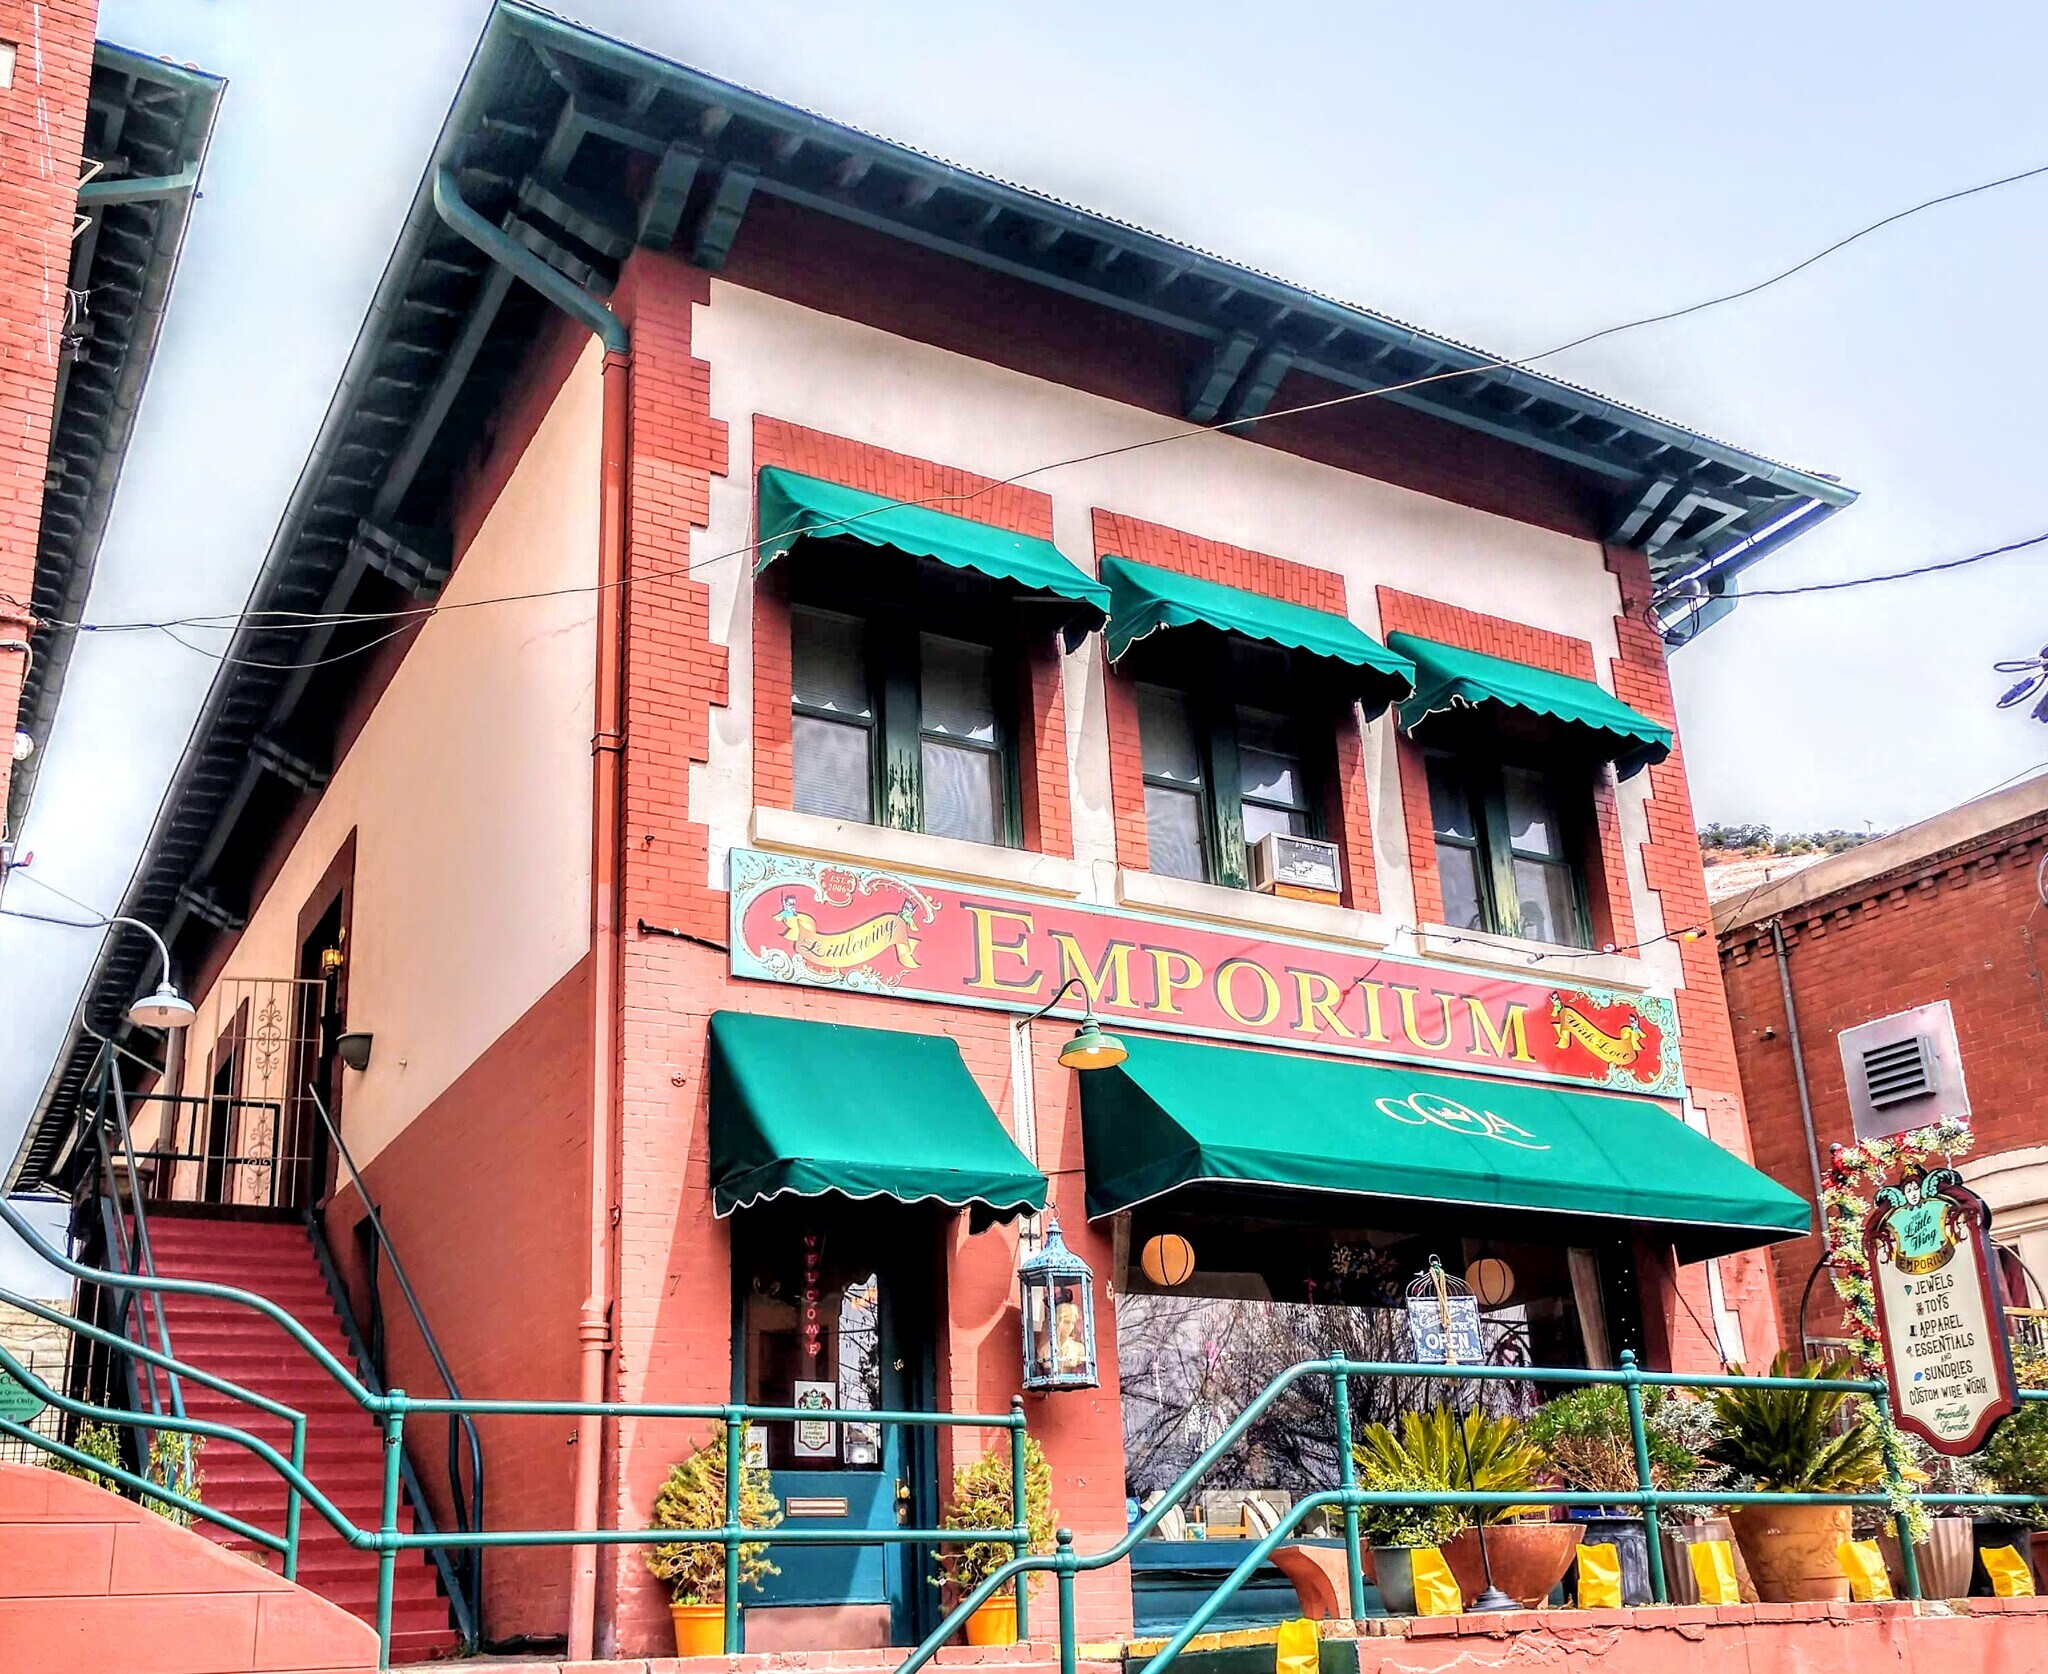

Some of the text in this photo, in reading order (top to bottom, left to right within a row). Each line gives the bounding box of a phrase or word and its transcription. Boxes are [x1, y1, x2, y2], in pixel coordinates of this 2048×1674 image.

[800, 920, 898, 957] Littlewing
[961, 901, 1537, 1063] EMPORIUM
[1566, 1014, 1629, 1060] With Love
[1904, 1210, 1933, 1241] Little
[1910, 1228, 1938, 1251] Wing
[1900, 1248, 1949, 1272] EMPORIUM
[1914, 1273, 1954, 1295] JEWELS
[1924, 1292, 1951, 1313] TOYS
[1920, 1314, 1963, 1338] APPAREL
[1425, 1332, 1470, 1350] OPEN
[1914, 1333, 1974, 1357] ESSENTIALS
[1940, 1352, 1952, 1362] AND
[1924, 1360, 1973, 1380] SUNDRIES
[1909, 1376, 1988, 1405] CUSTOM WIRE WORK
[1933, 1404, 1970, 1422] Friendly
[1938, 1420, 1969, 1434] Service
